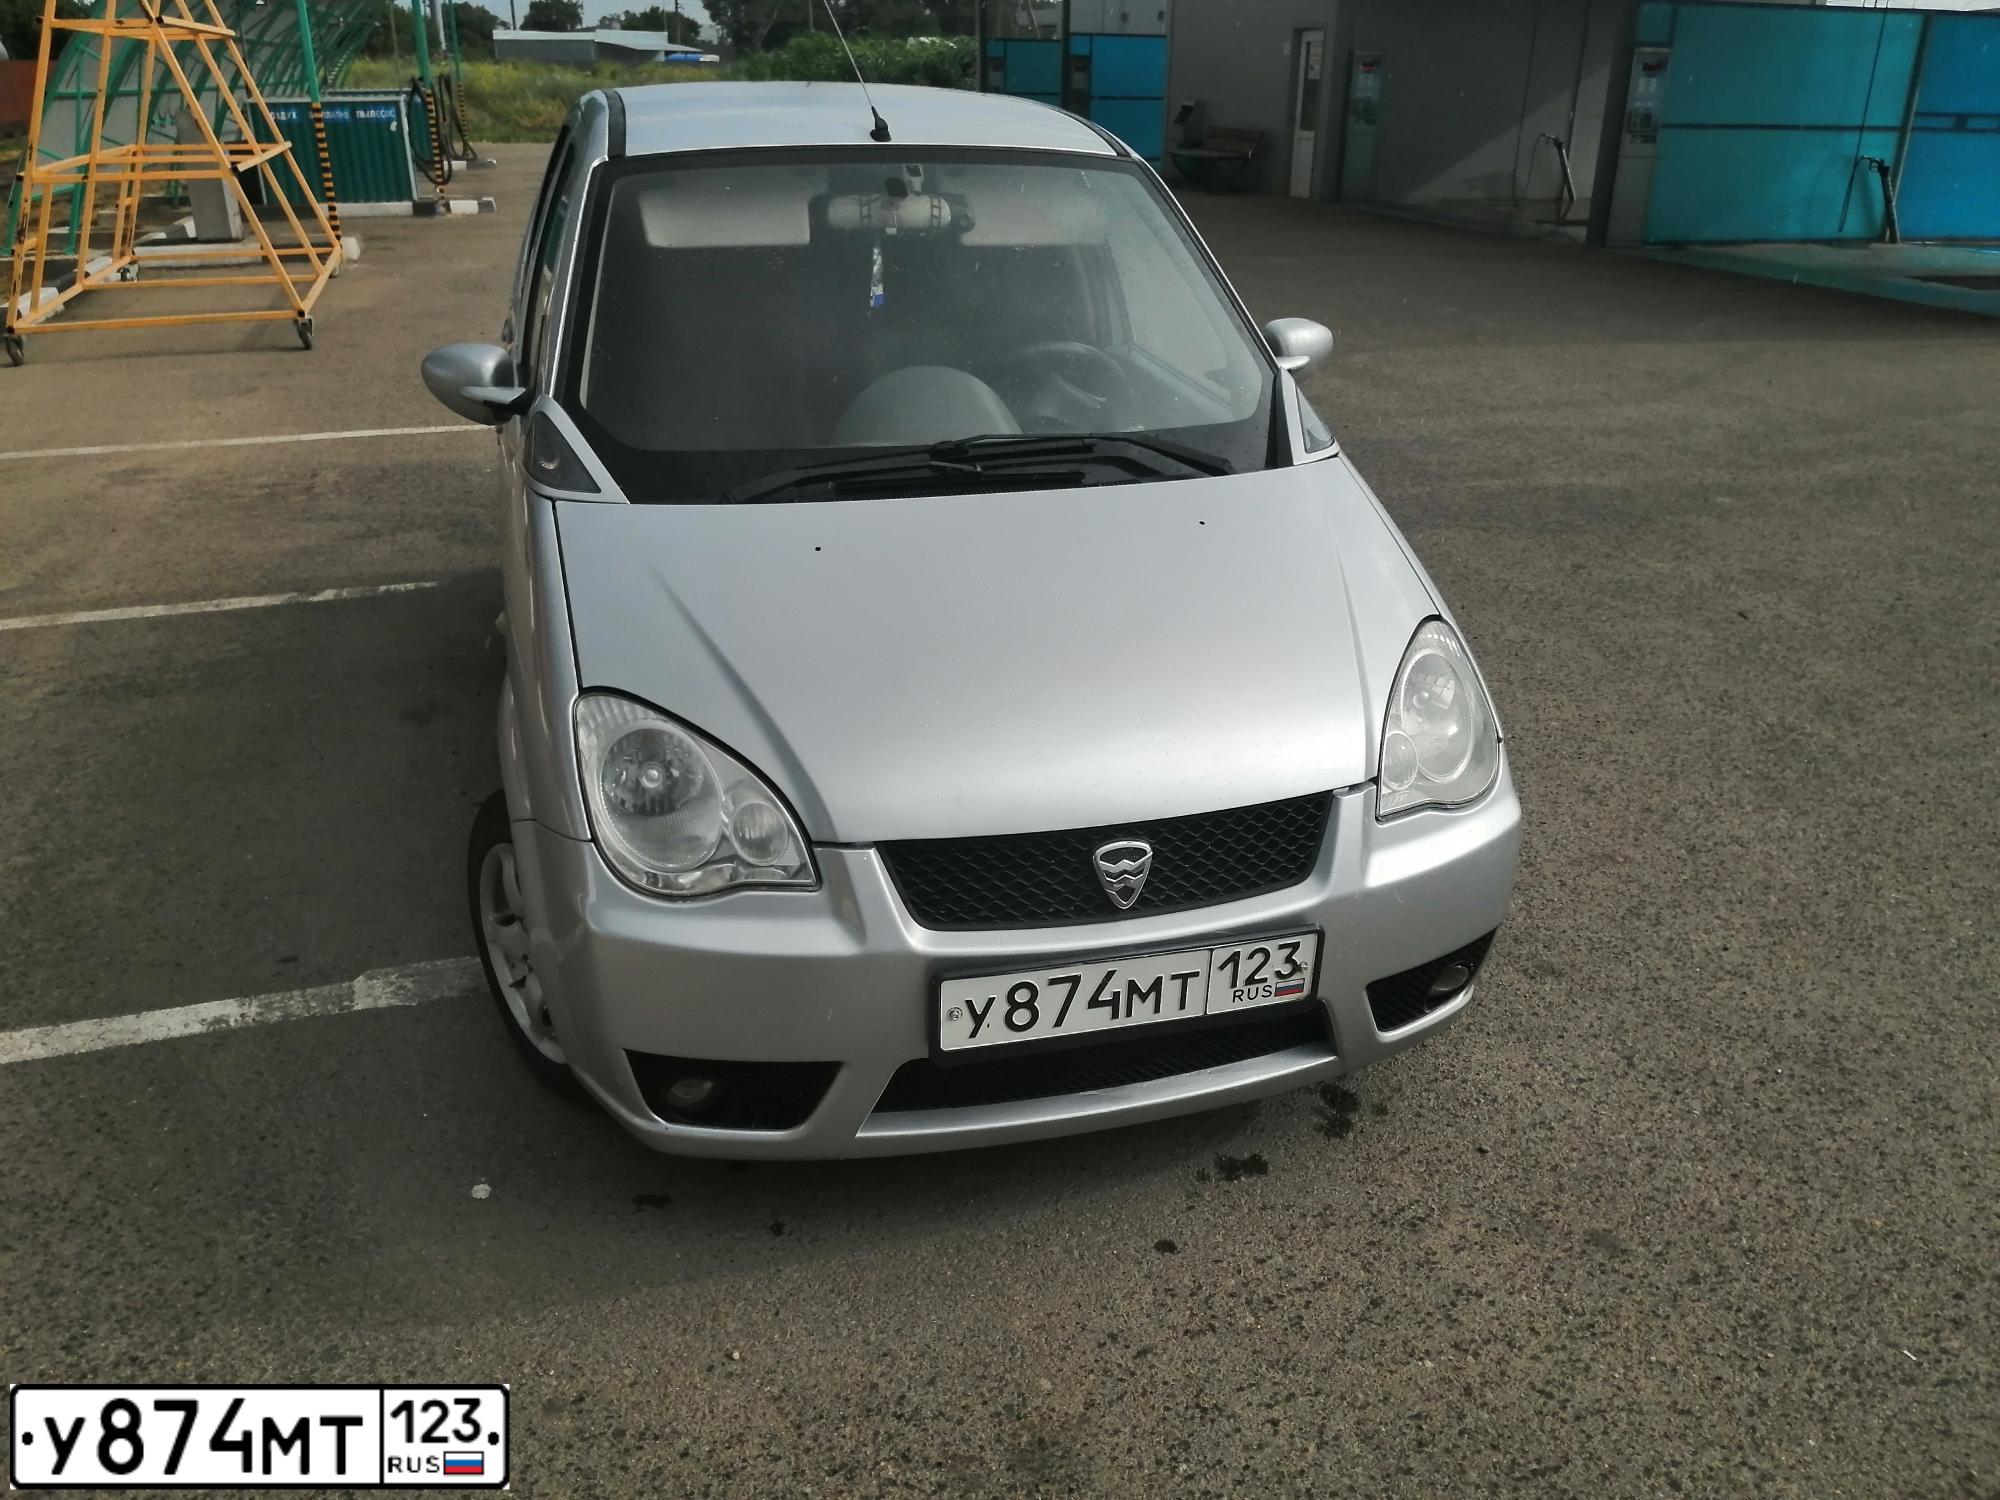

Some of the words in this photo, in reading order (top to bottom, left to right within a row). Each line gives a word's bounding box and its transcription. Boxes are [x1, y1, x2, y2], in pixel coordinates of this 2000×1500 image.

[965, 969, 1200, 1038] У874МТ
[1218, 942, 1301, 989] 123
[1232, 984, 1273, 1003] RUS
